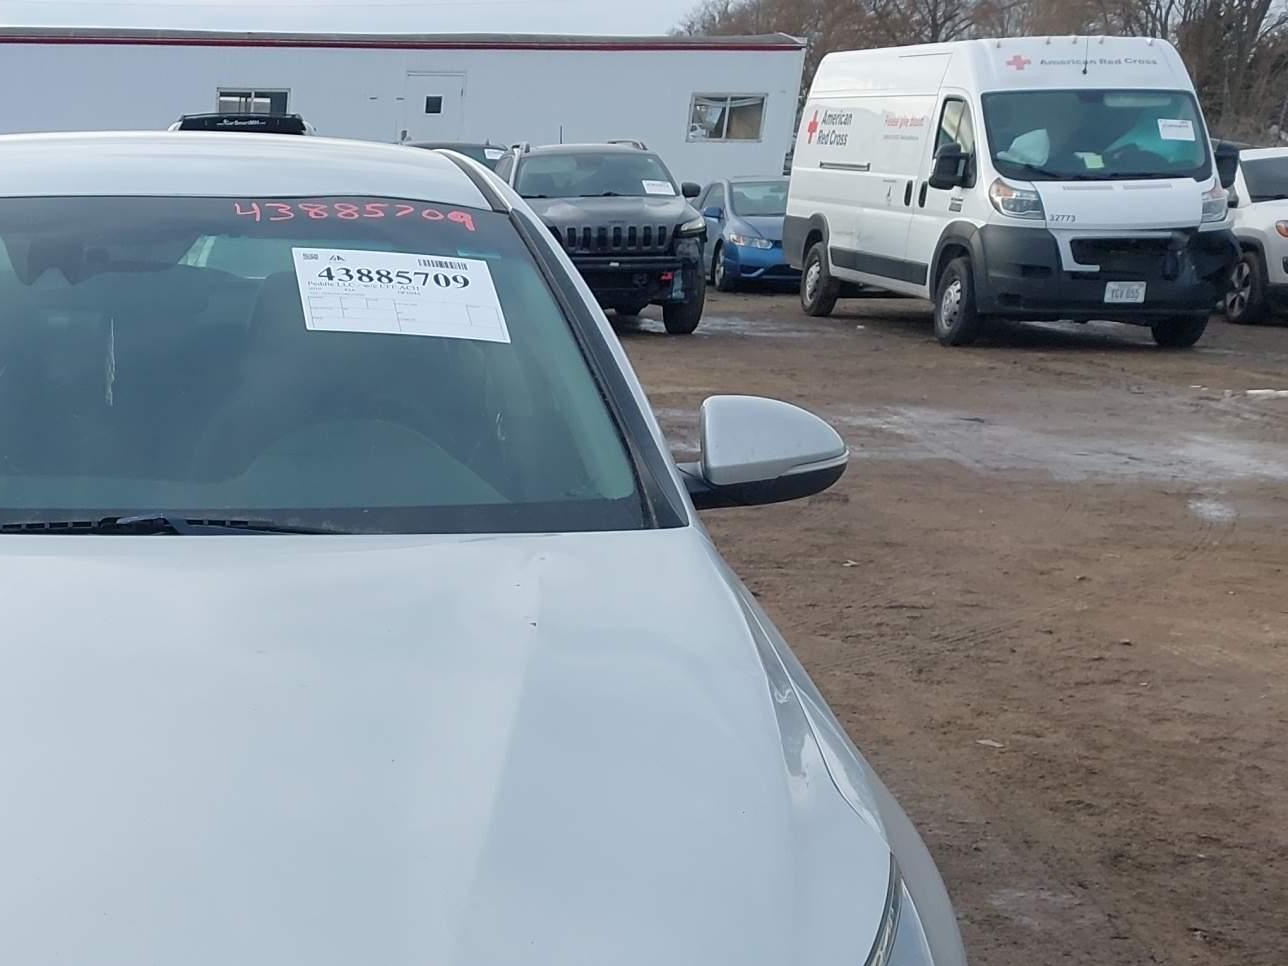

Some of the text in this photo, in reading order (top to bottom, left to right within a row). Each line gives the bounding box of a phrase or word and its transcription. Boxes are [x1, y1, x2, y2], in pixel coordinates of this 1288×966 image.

[1124, 57, 1158, 65] Cross
[821, 110, 853, 126] American
[817, 130, 848, 146] Red Cross
[234, 202, 476, 231] 43885709
[317, 266, 470, 289] 43885709
